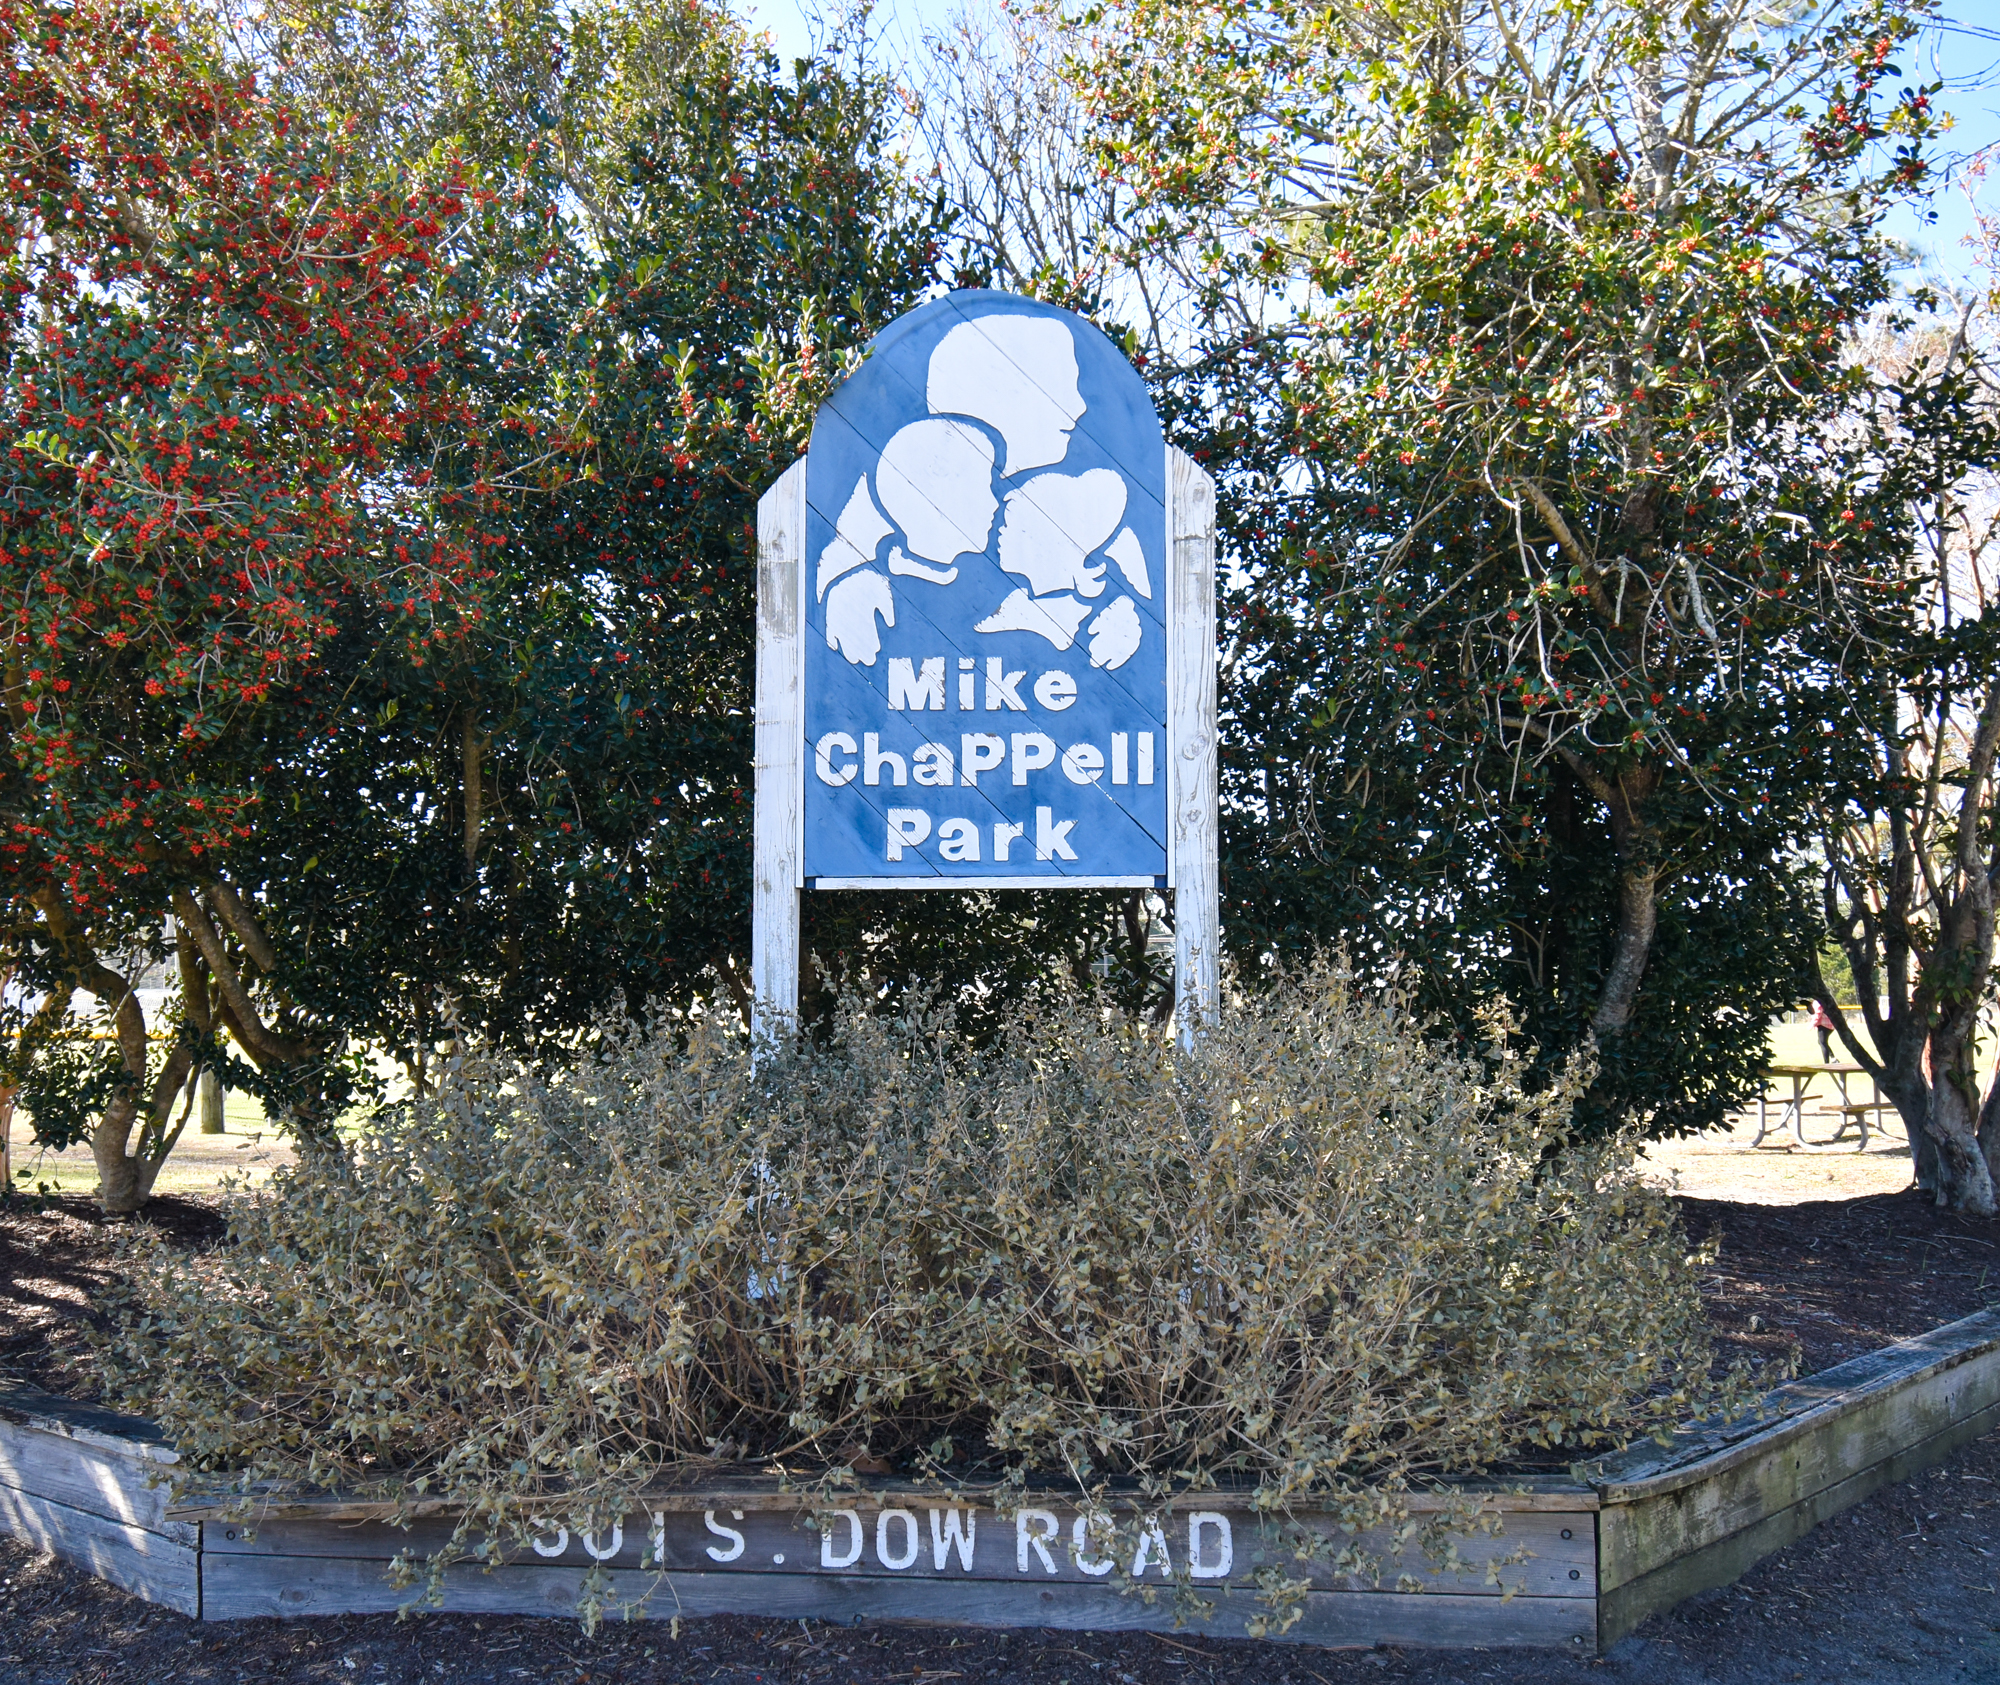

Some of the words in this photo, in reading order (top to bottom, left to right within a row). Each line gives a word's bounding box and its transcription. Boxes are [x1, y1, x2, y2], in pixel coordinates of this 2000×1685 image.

[887, 656, 1078, 712] Mike
[886, 806, 1079, 862] Park
[819, 1509, 976, 1572] DOW
[1016, 1508, 1234, 1578] ROAD
